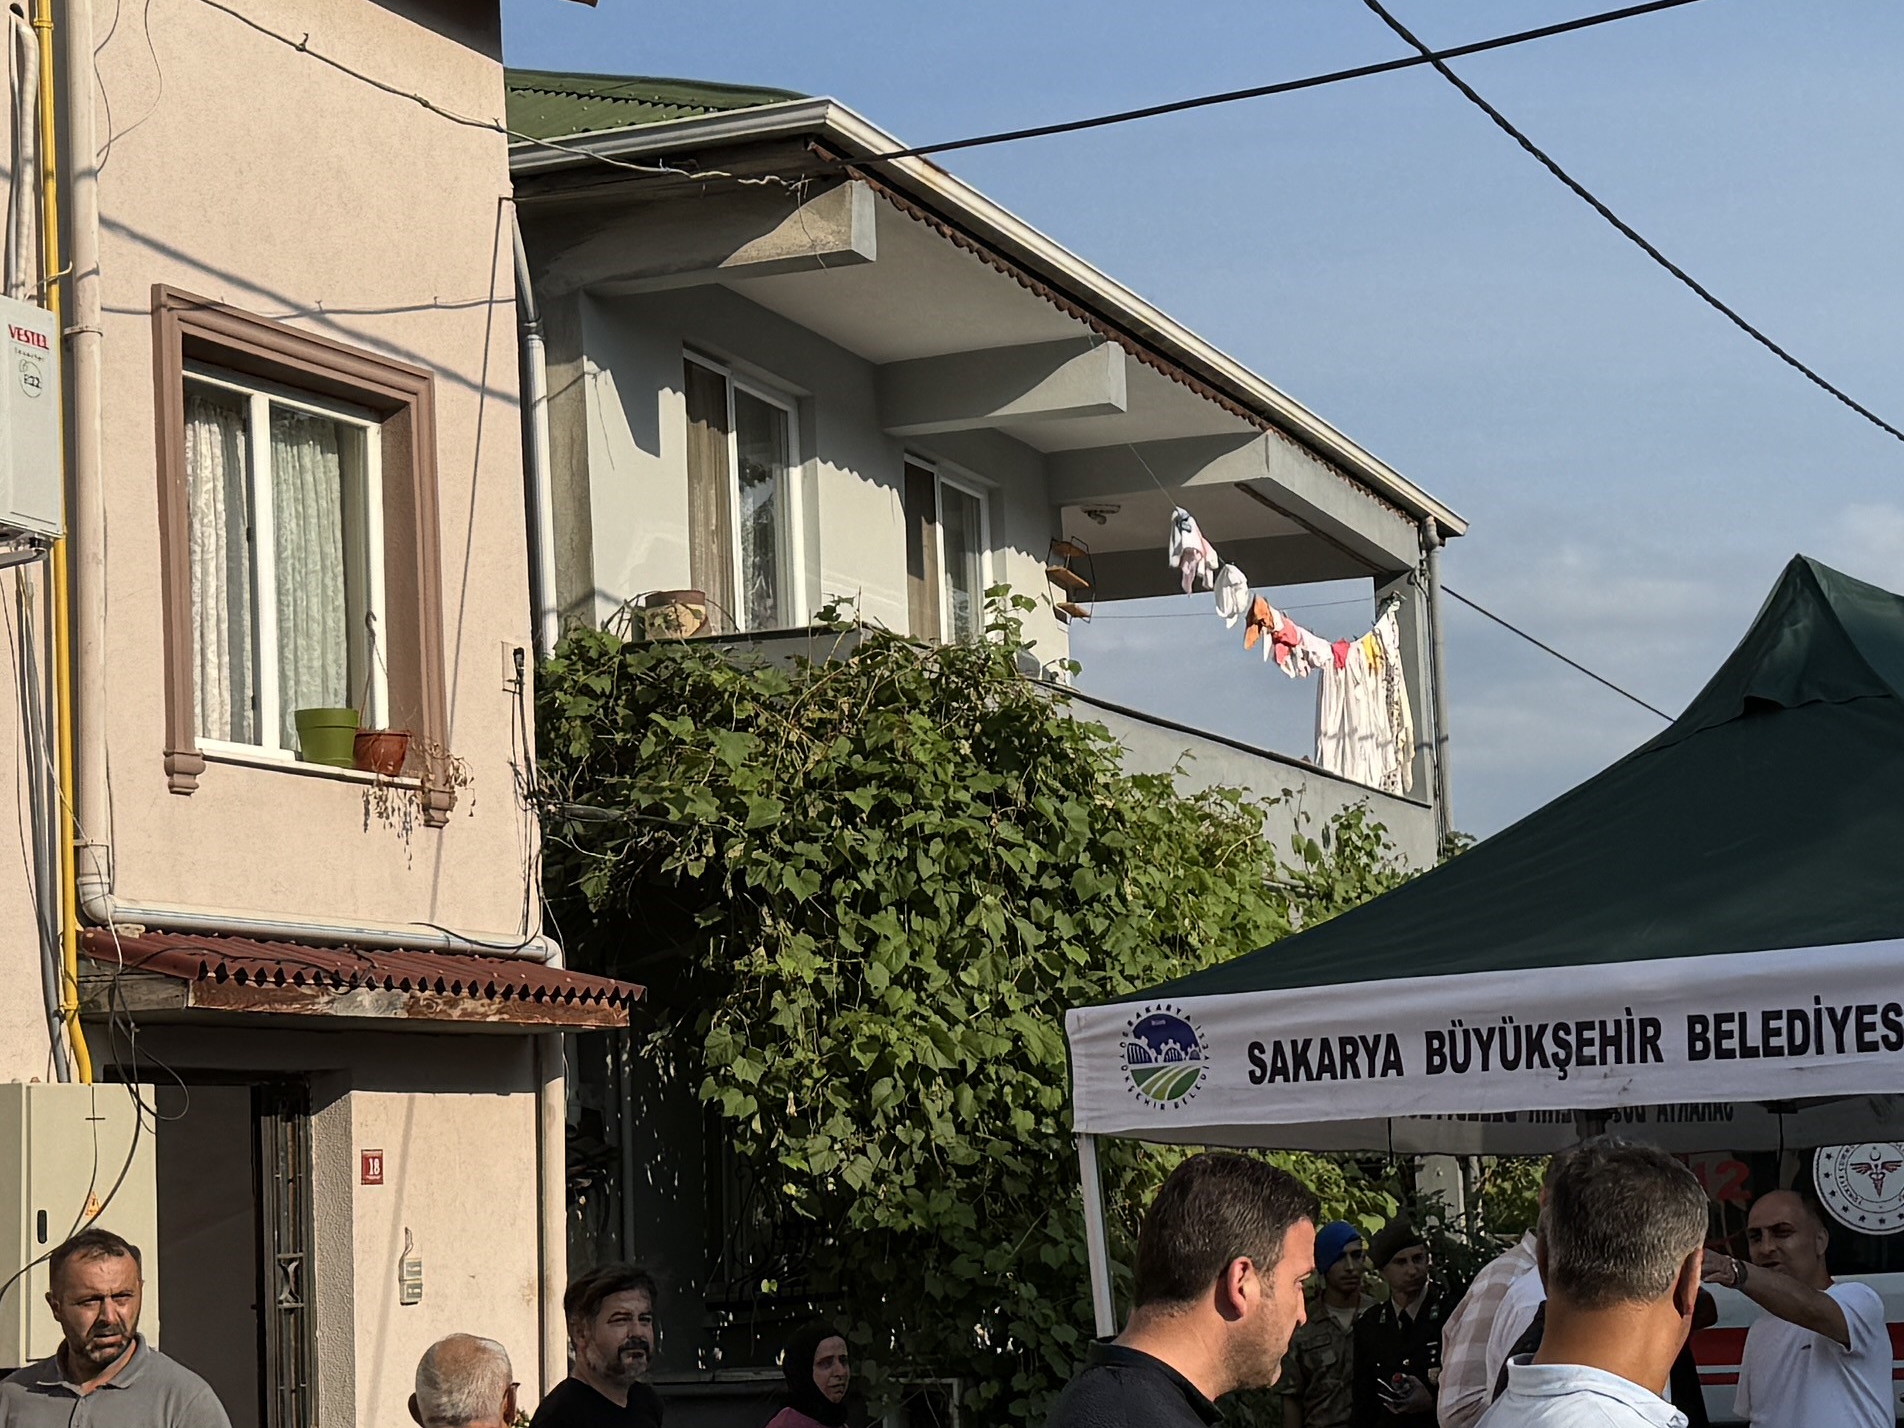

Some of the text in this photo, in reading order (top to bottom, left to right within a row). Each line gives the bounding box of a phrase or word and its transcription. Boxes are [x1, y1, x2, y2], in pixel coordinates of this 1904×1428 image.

[8, 324, 50, 350] VESTEL
[1247, 1032, 1404, 1085] SAKARYA
[1424, 1007, 1664, 1081] BÜYÜKŞEHİR
[368, 1157, 381, 1175] 18
